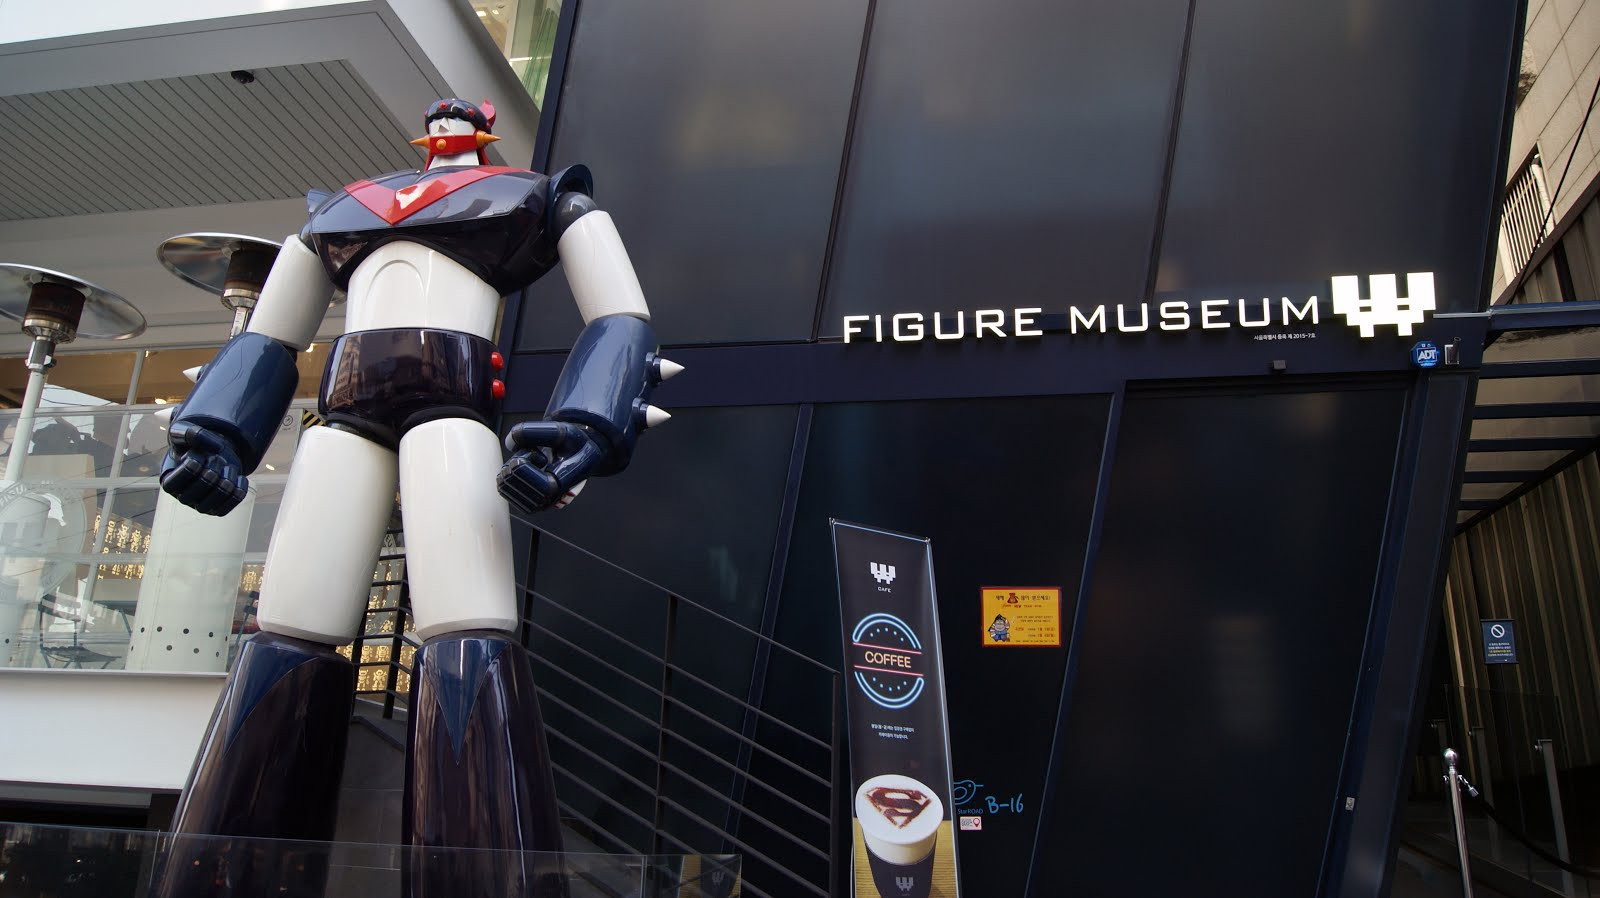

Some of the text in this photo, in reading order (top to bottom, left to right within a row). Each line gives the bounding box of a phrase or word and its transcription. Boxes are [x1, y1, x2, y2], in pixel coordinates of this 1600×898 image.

[843, 307, 1043, 344] FIGURE
[1070, 295, 1319, 334] MUSEUM
[1418, 350, 1437, 361] ADT
[864, 651, 912, 668] COFFEE
[985, 793, 1024, 814] B-16
